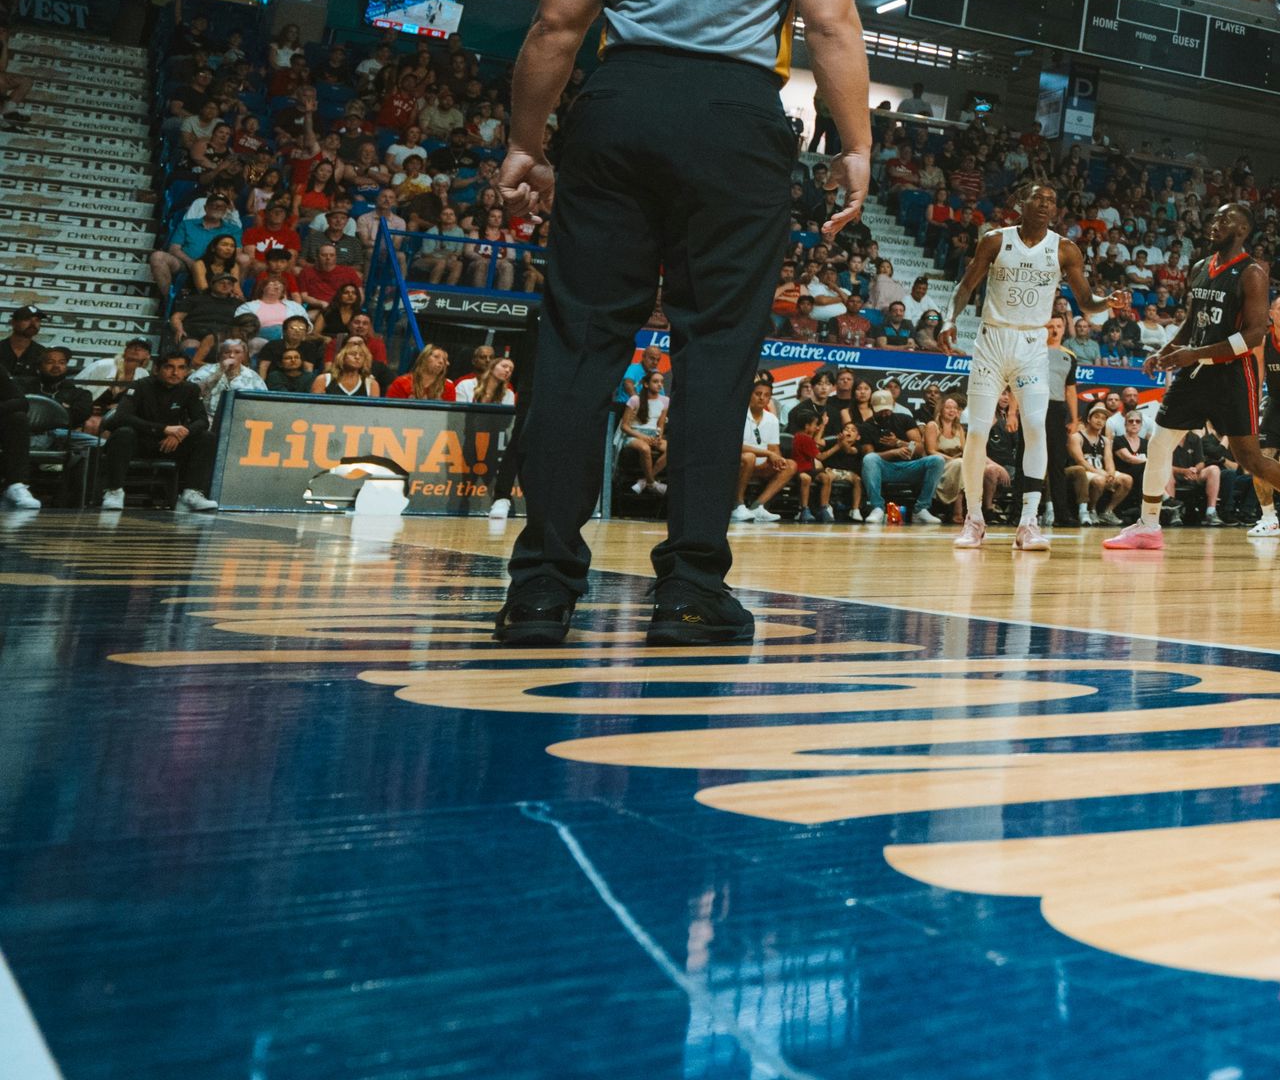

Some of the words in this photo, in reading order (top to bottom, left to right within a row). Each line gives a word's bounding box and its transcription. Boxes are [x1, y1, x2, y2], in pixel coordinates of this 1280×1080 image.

[1092, 15, 1119, 32] HOME
[1214, 19, 1246, 36] PLAYER
[1171, 33, 1200, 49] GUEST
[71, 120, 134, 134] CHEVROLET
[70, 144, 136, 160] CHEVROLET
[69, 171, 137, 186] CHEVROLET
[68, 200, 140, 215] CHEVROLET
[67, 230, 140, 245] CHEVROLET
[64, 260, 140, 276] CHEVROLET
[65, 297, 143, 311] CHEVROLET
[1006, 286, 1039, 308] 30
[409, 479, 452, 498] Feel
[455, 479, 488, 498] the
